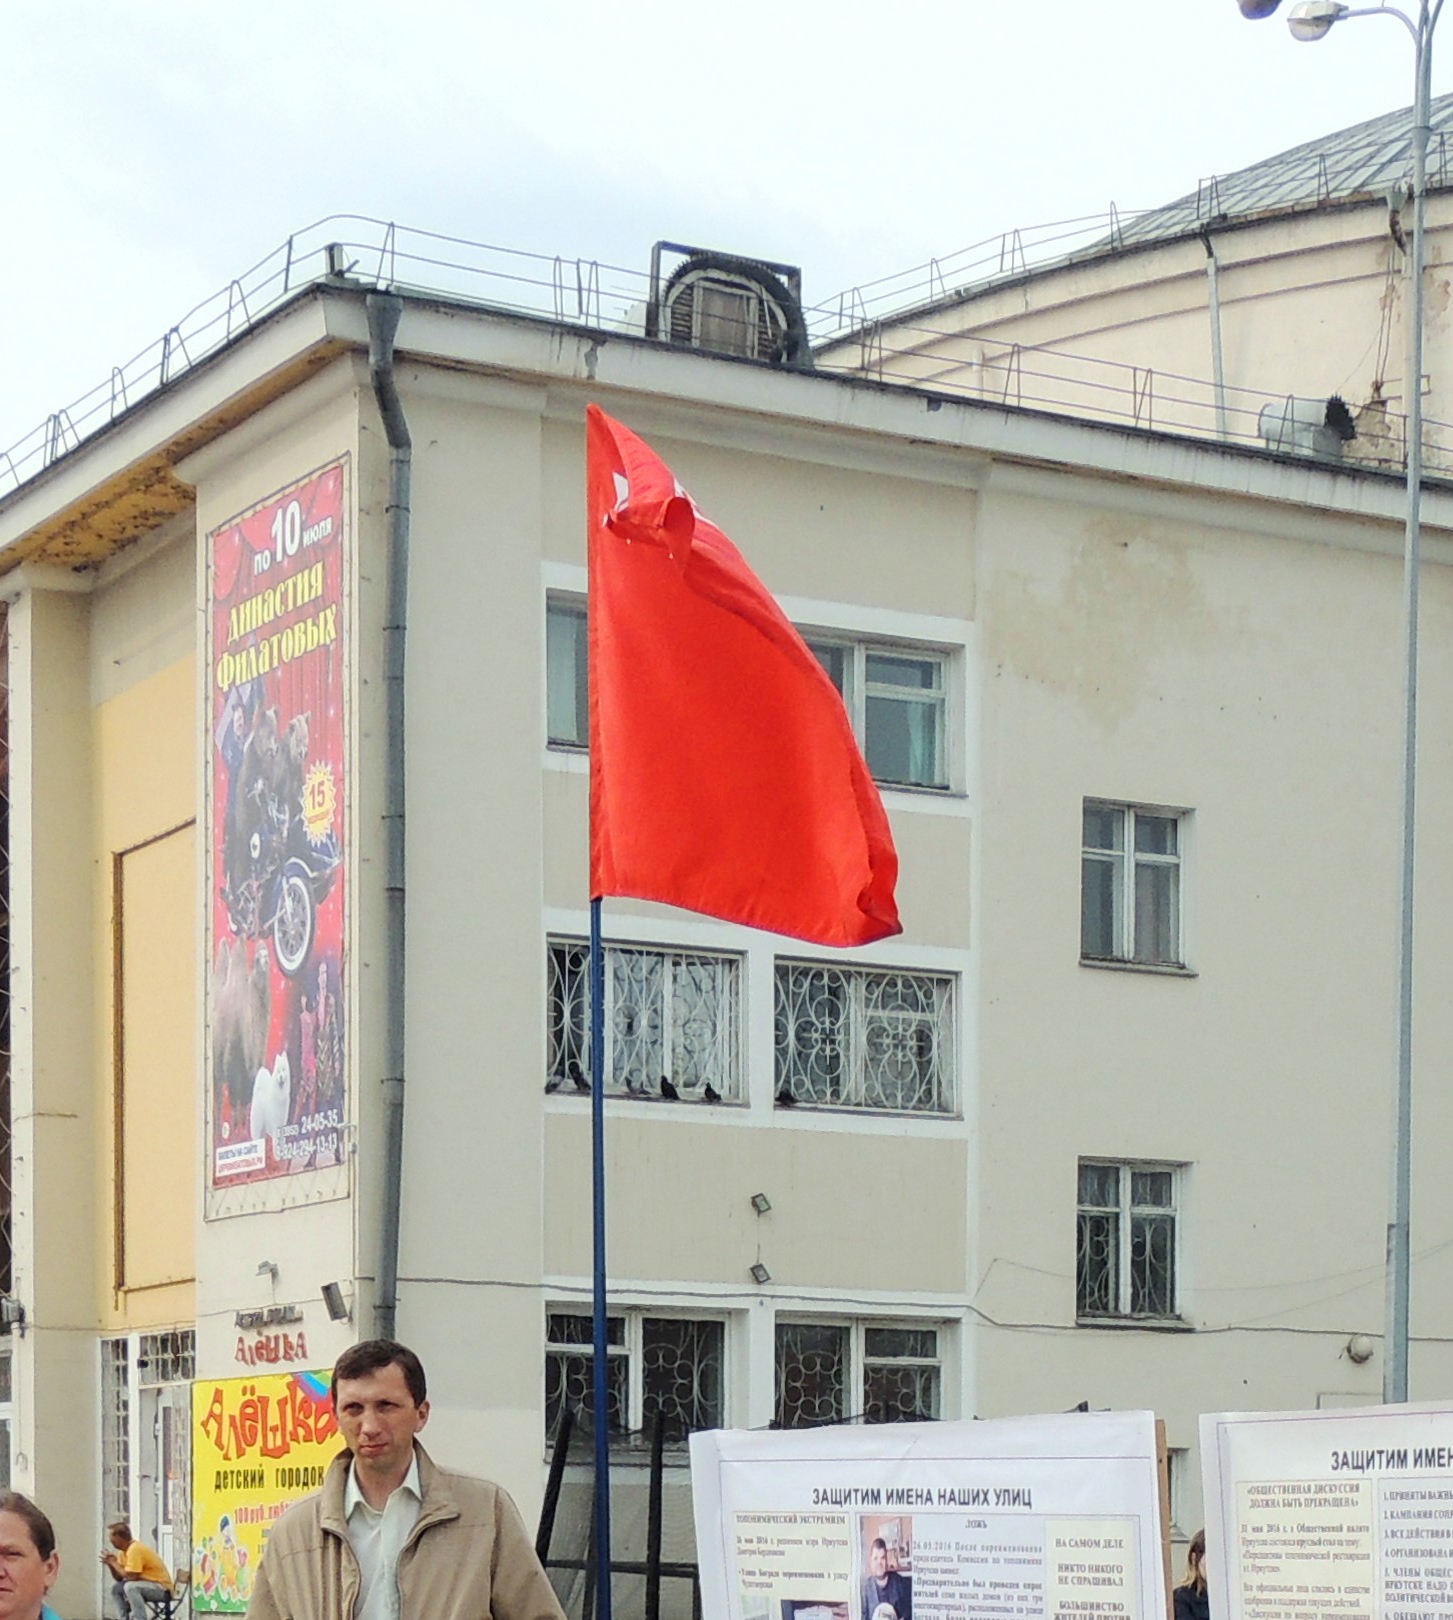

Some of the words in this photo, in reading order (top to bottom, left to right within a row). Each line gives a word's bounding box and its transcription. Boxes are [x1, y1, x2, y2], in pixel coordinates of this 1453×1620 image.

[271, 500, 302, 562] 10
[309, 782, 326, 811] 15
[1331, 1449, 1408, 1473] ЗАЩИТИМ
[214, 1464, 265, 1493] детский
[275, 1466, 324, 1491] городок
[812, 1488, 882, 1508] ЗАЩИТИМ
[886, 1488, 934, 1506] ИМЕНА
[938, 1488, 990, 1506] НАШИХ
[994, 1489, 1033, 1509] УЛИЦ
[1055, 1538, 1067, 1548] НА
[1068, 1538, 1101, 1548] САМОМ
[1103, 1539, 1124, 1549] ДЕЛЕ
[1058, 1576, 1069, 1586] НЕ
